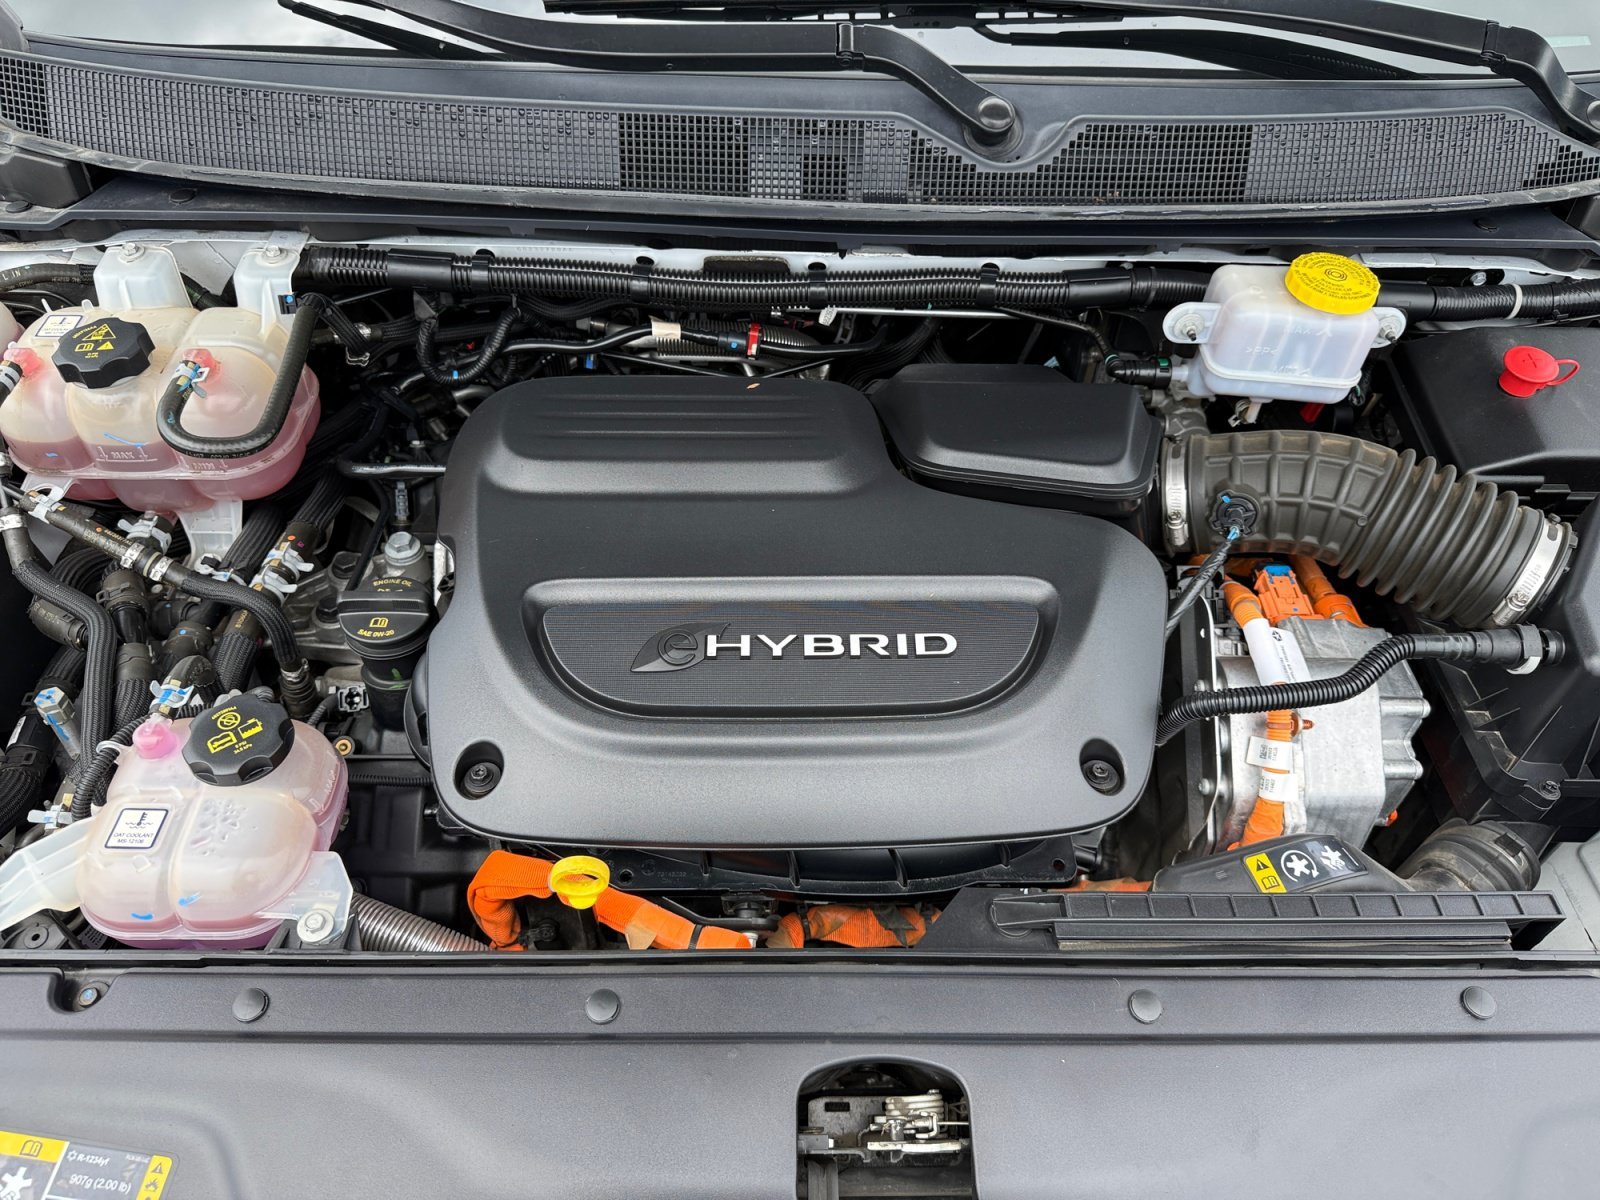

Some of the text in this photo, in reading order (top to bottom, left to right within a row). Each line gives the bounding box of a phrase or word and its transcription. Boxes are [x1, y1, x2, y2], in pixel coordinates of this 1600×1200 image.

[373, 579, 413, 587] ENGINE OIL
[357, 628, 372, 637] SAE
[705, 633, 957, 660] HYBRID
[77, 1153, 110, 1167] R-1234yf
[69, 1173, 132, 1195] 907g (2.00 lb)
